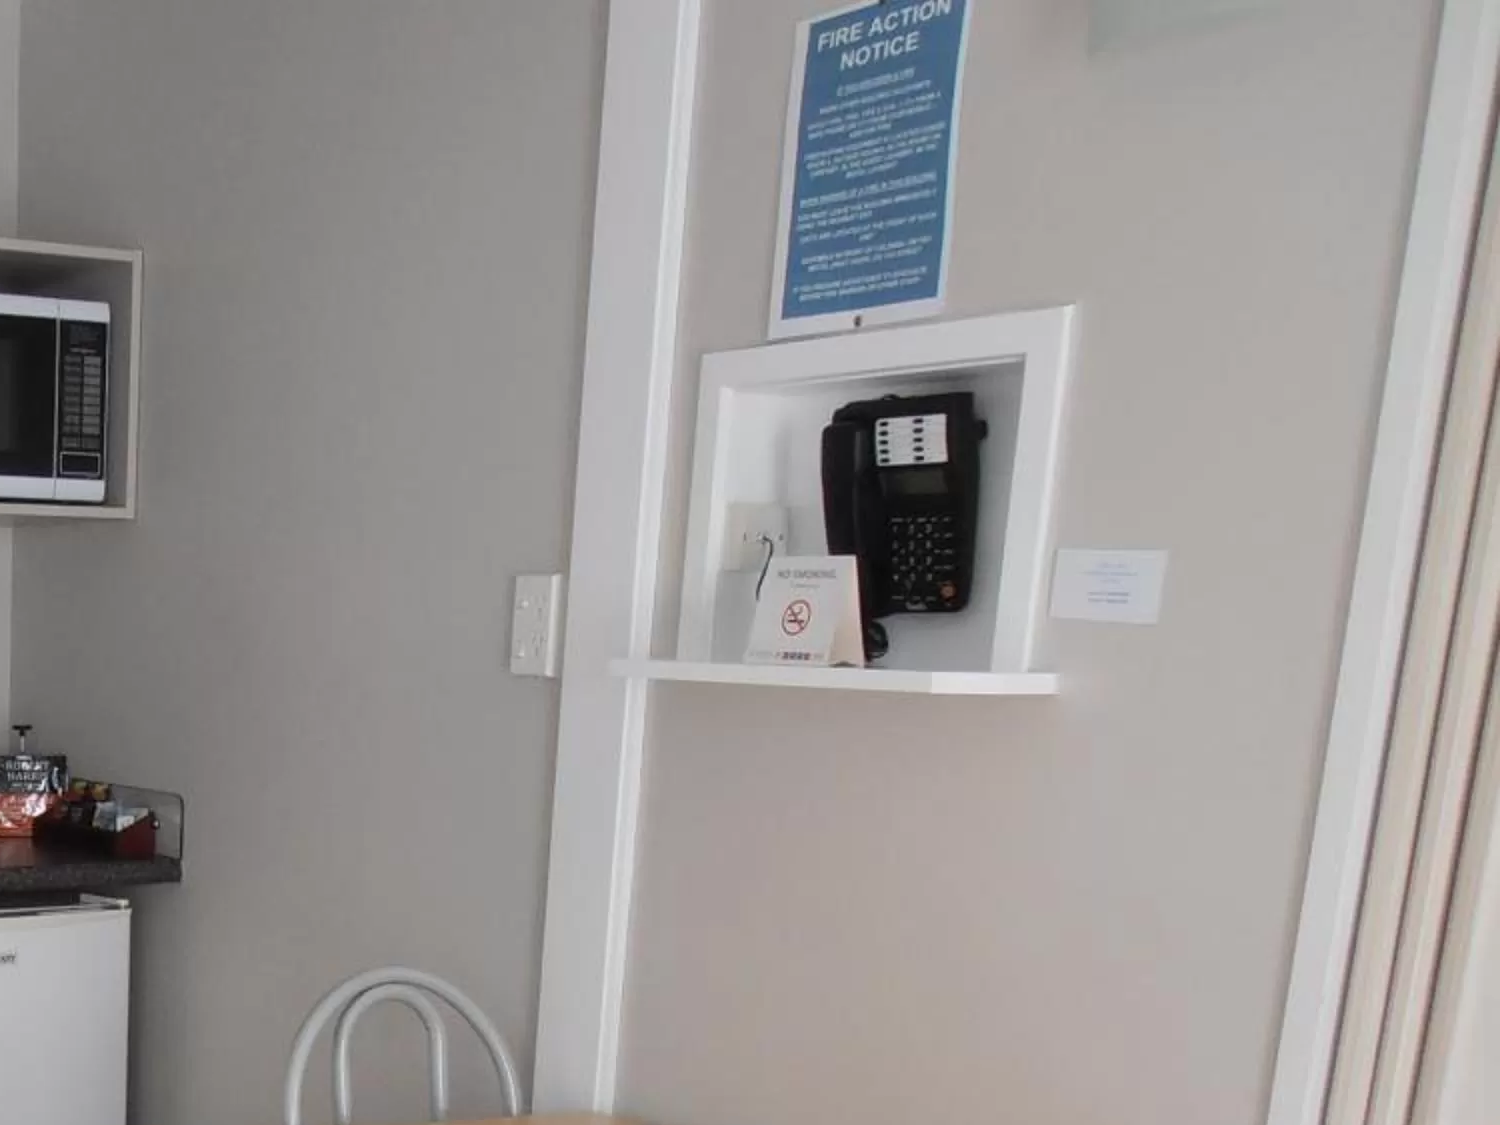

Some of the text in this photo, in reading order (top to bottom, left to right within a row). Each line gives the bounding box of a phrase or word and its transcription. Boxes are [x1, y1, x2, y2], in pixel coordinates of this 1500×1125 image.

[817, 0, 951, 53] FIRE ACTION
[839, 31, 921, 71] NOTICE
